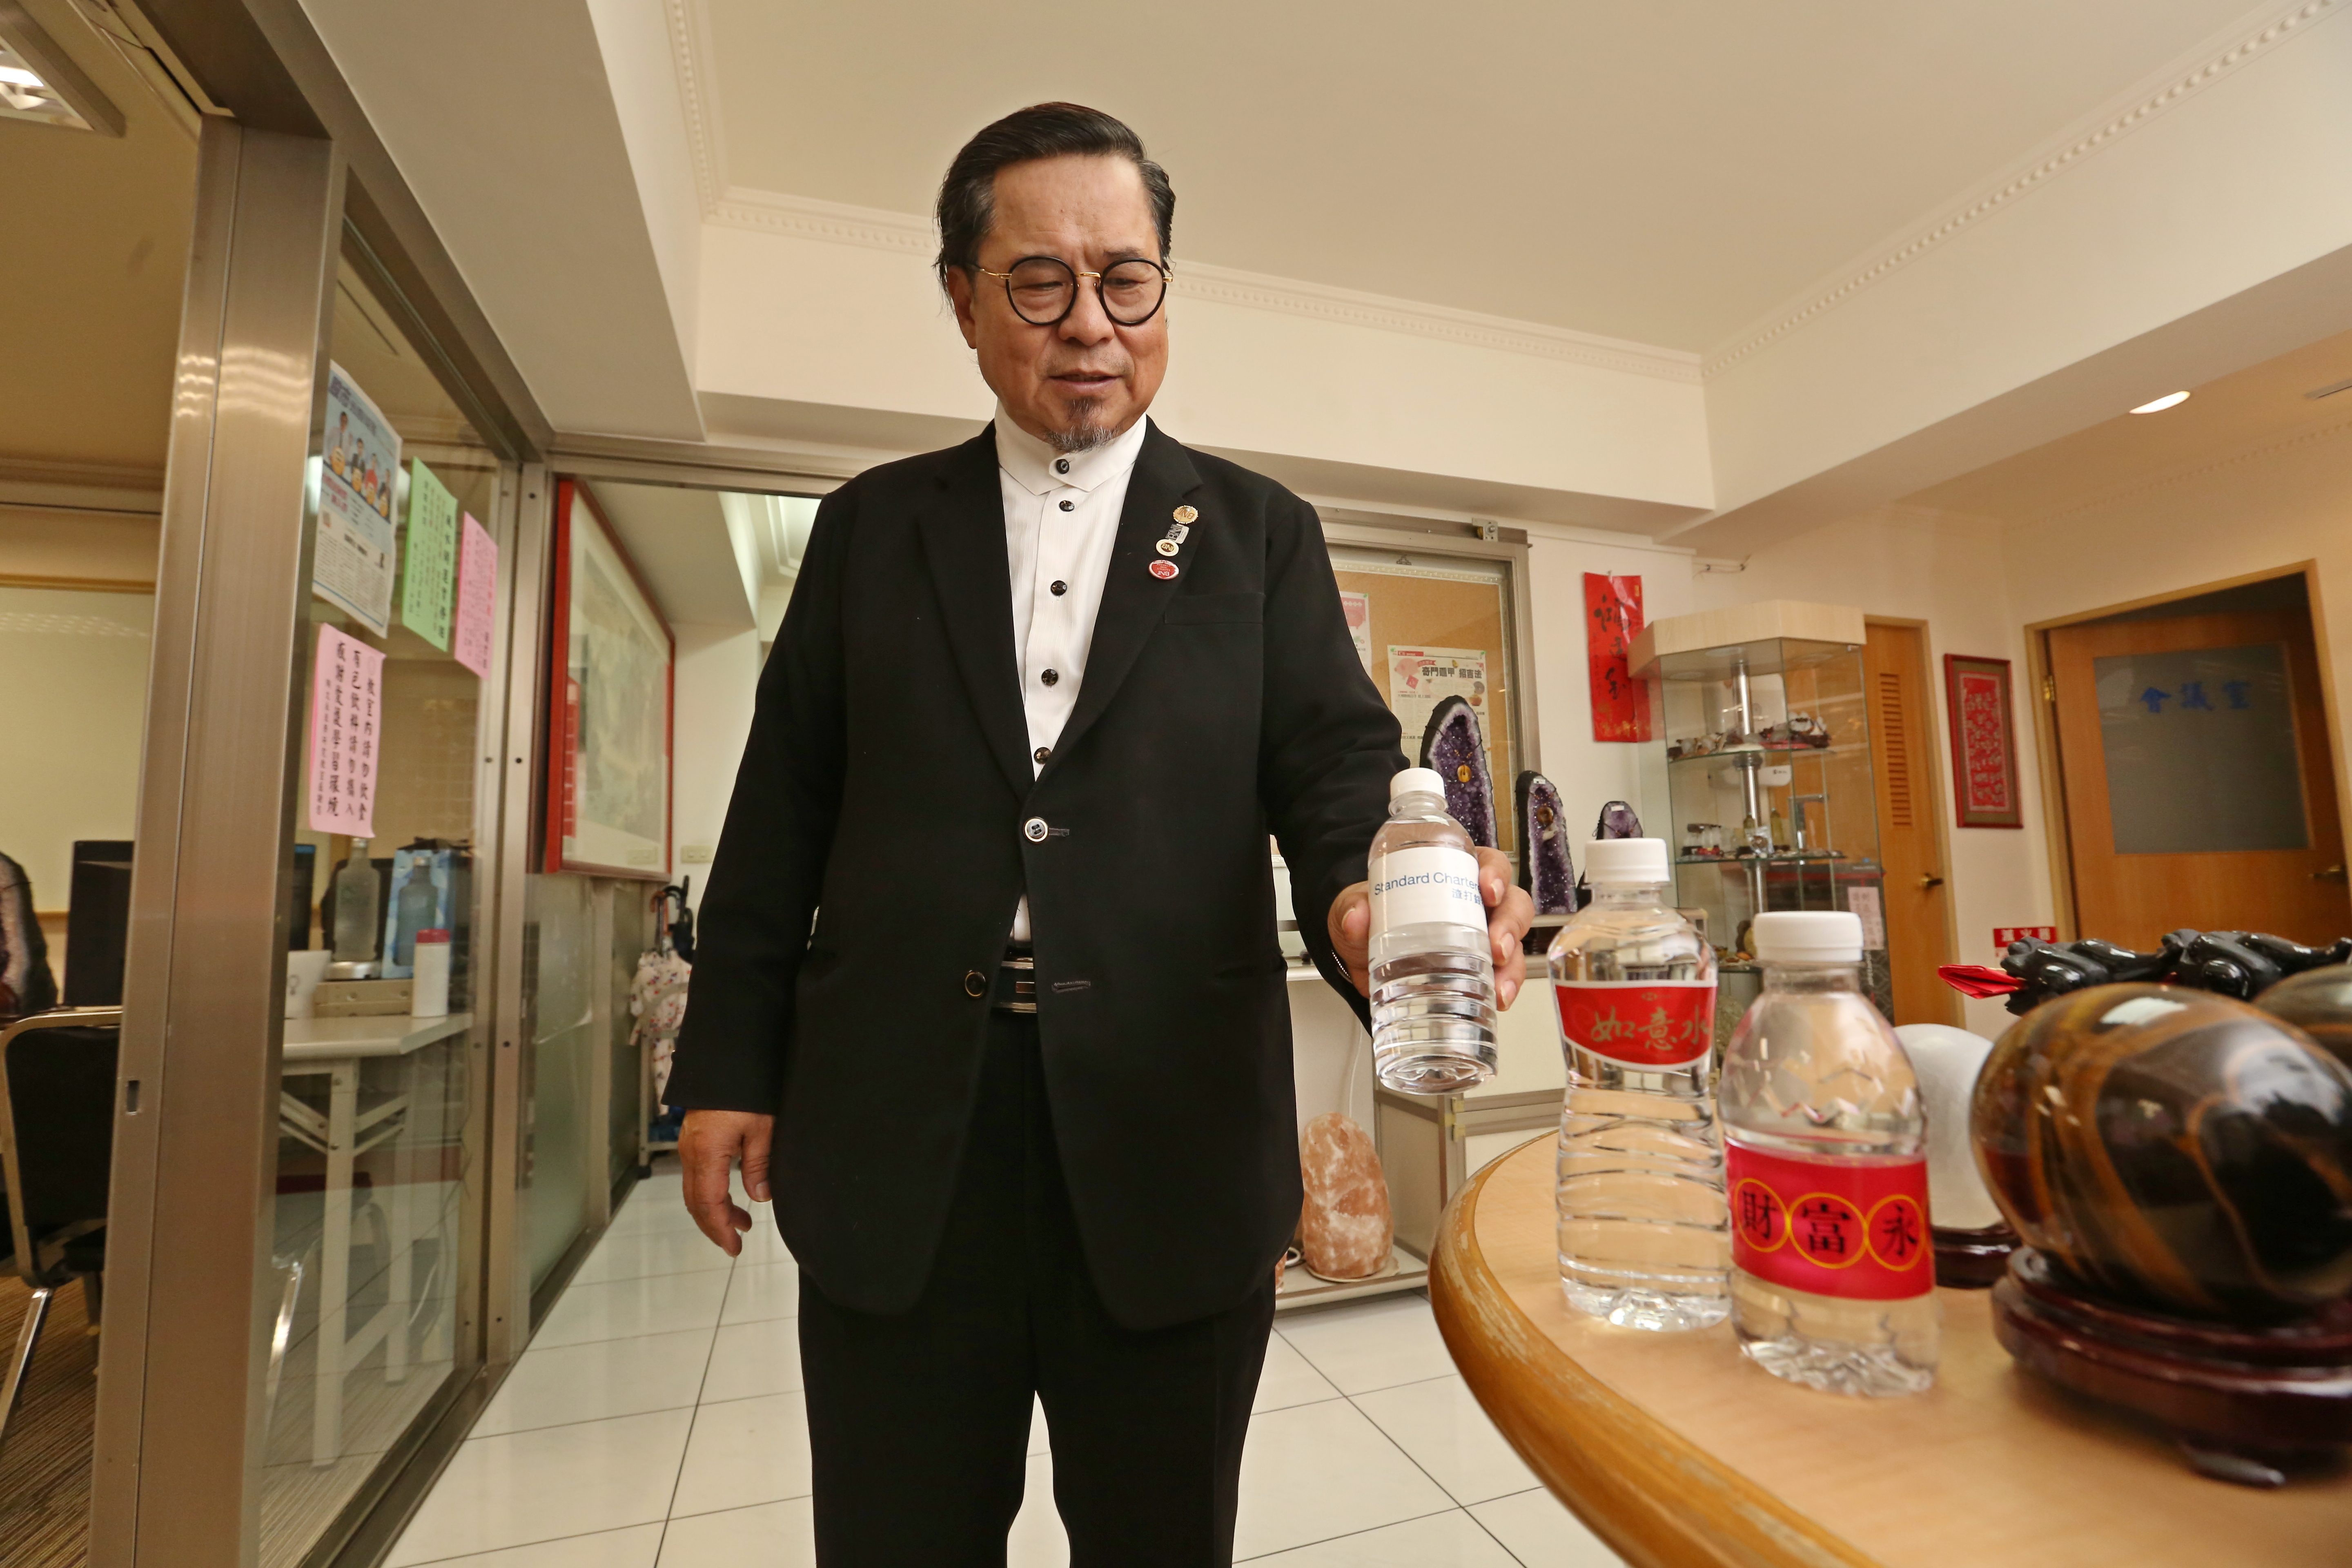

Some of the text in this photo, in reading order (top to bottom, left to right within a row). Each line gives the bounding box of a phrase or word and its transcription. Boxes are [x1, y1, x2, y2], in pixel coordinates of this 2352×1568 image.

[1374, 873, 1429, 895] Standard
[1452, 888, 1483, 905] 渣打銀
